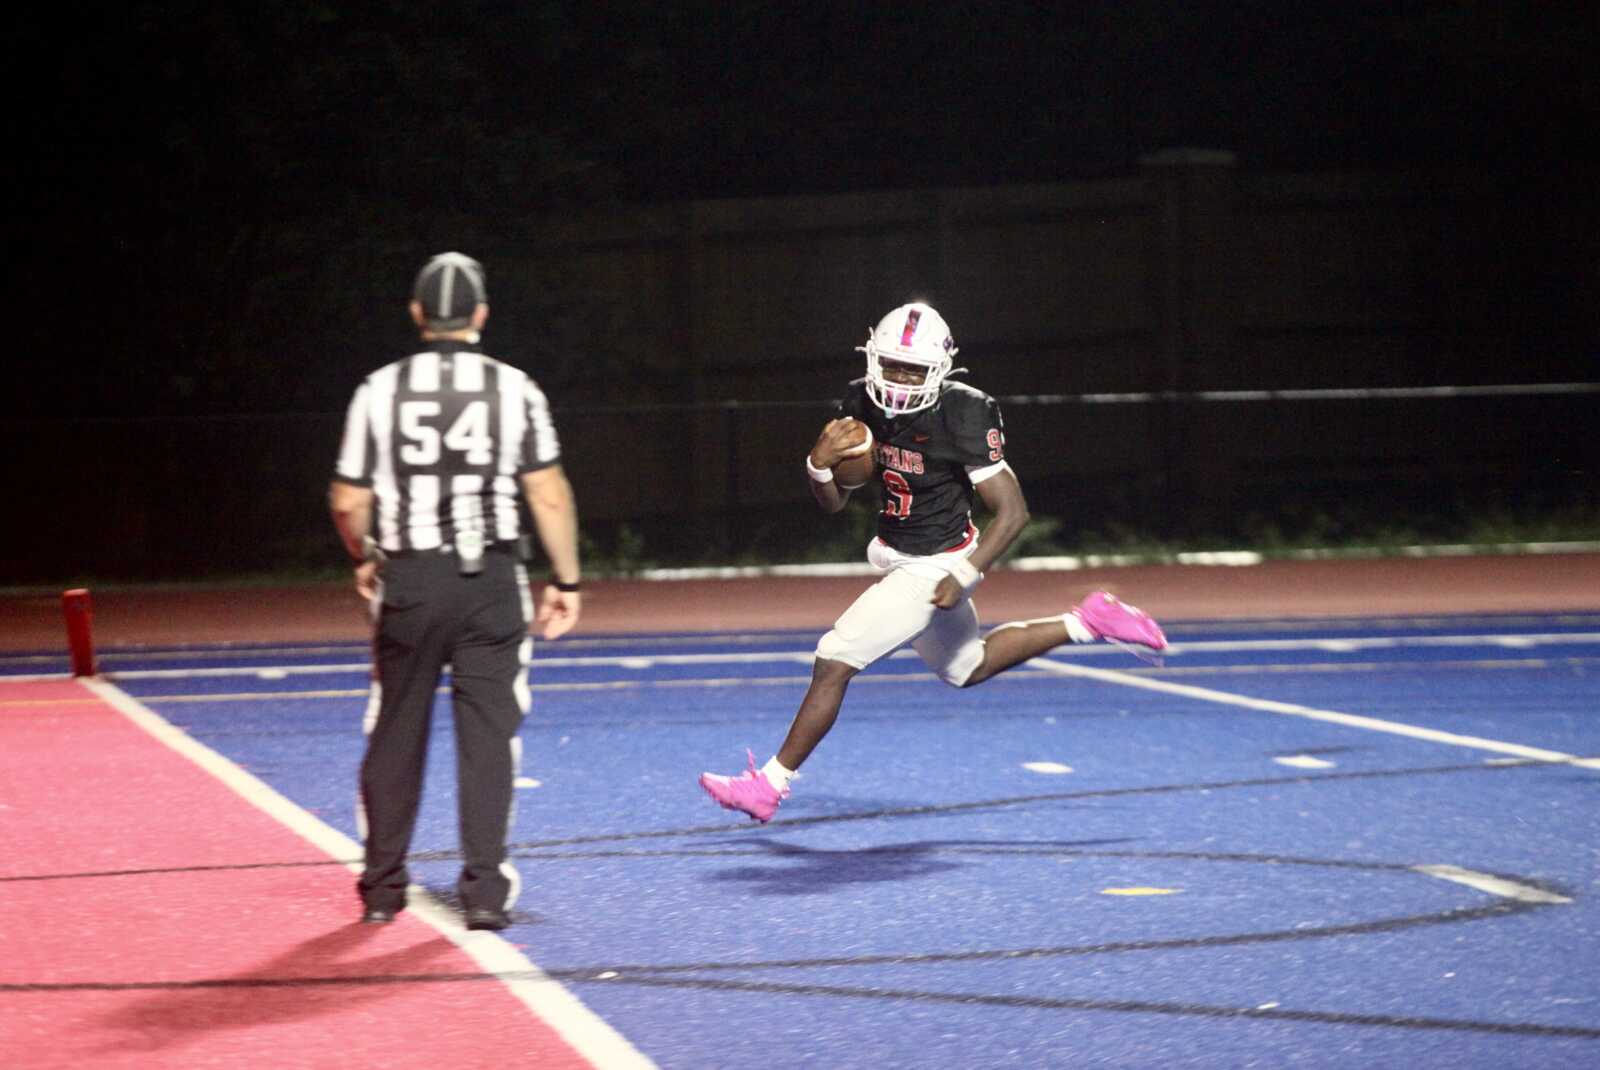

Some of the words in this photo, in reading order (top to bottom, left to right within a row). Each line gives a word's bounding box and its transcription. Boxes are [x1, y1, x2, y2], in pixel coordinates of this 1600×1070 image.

[400, 401, 493, 465] 54
[986, 428, 1003, 462] 9
[882, 469, 913, 520] 9
